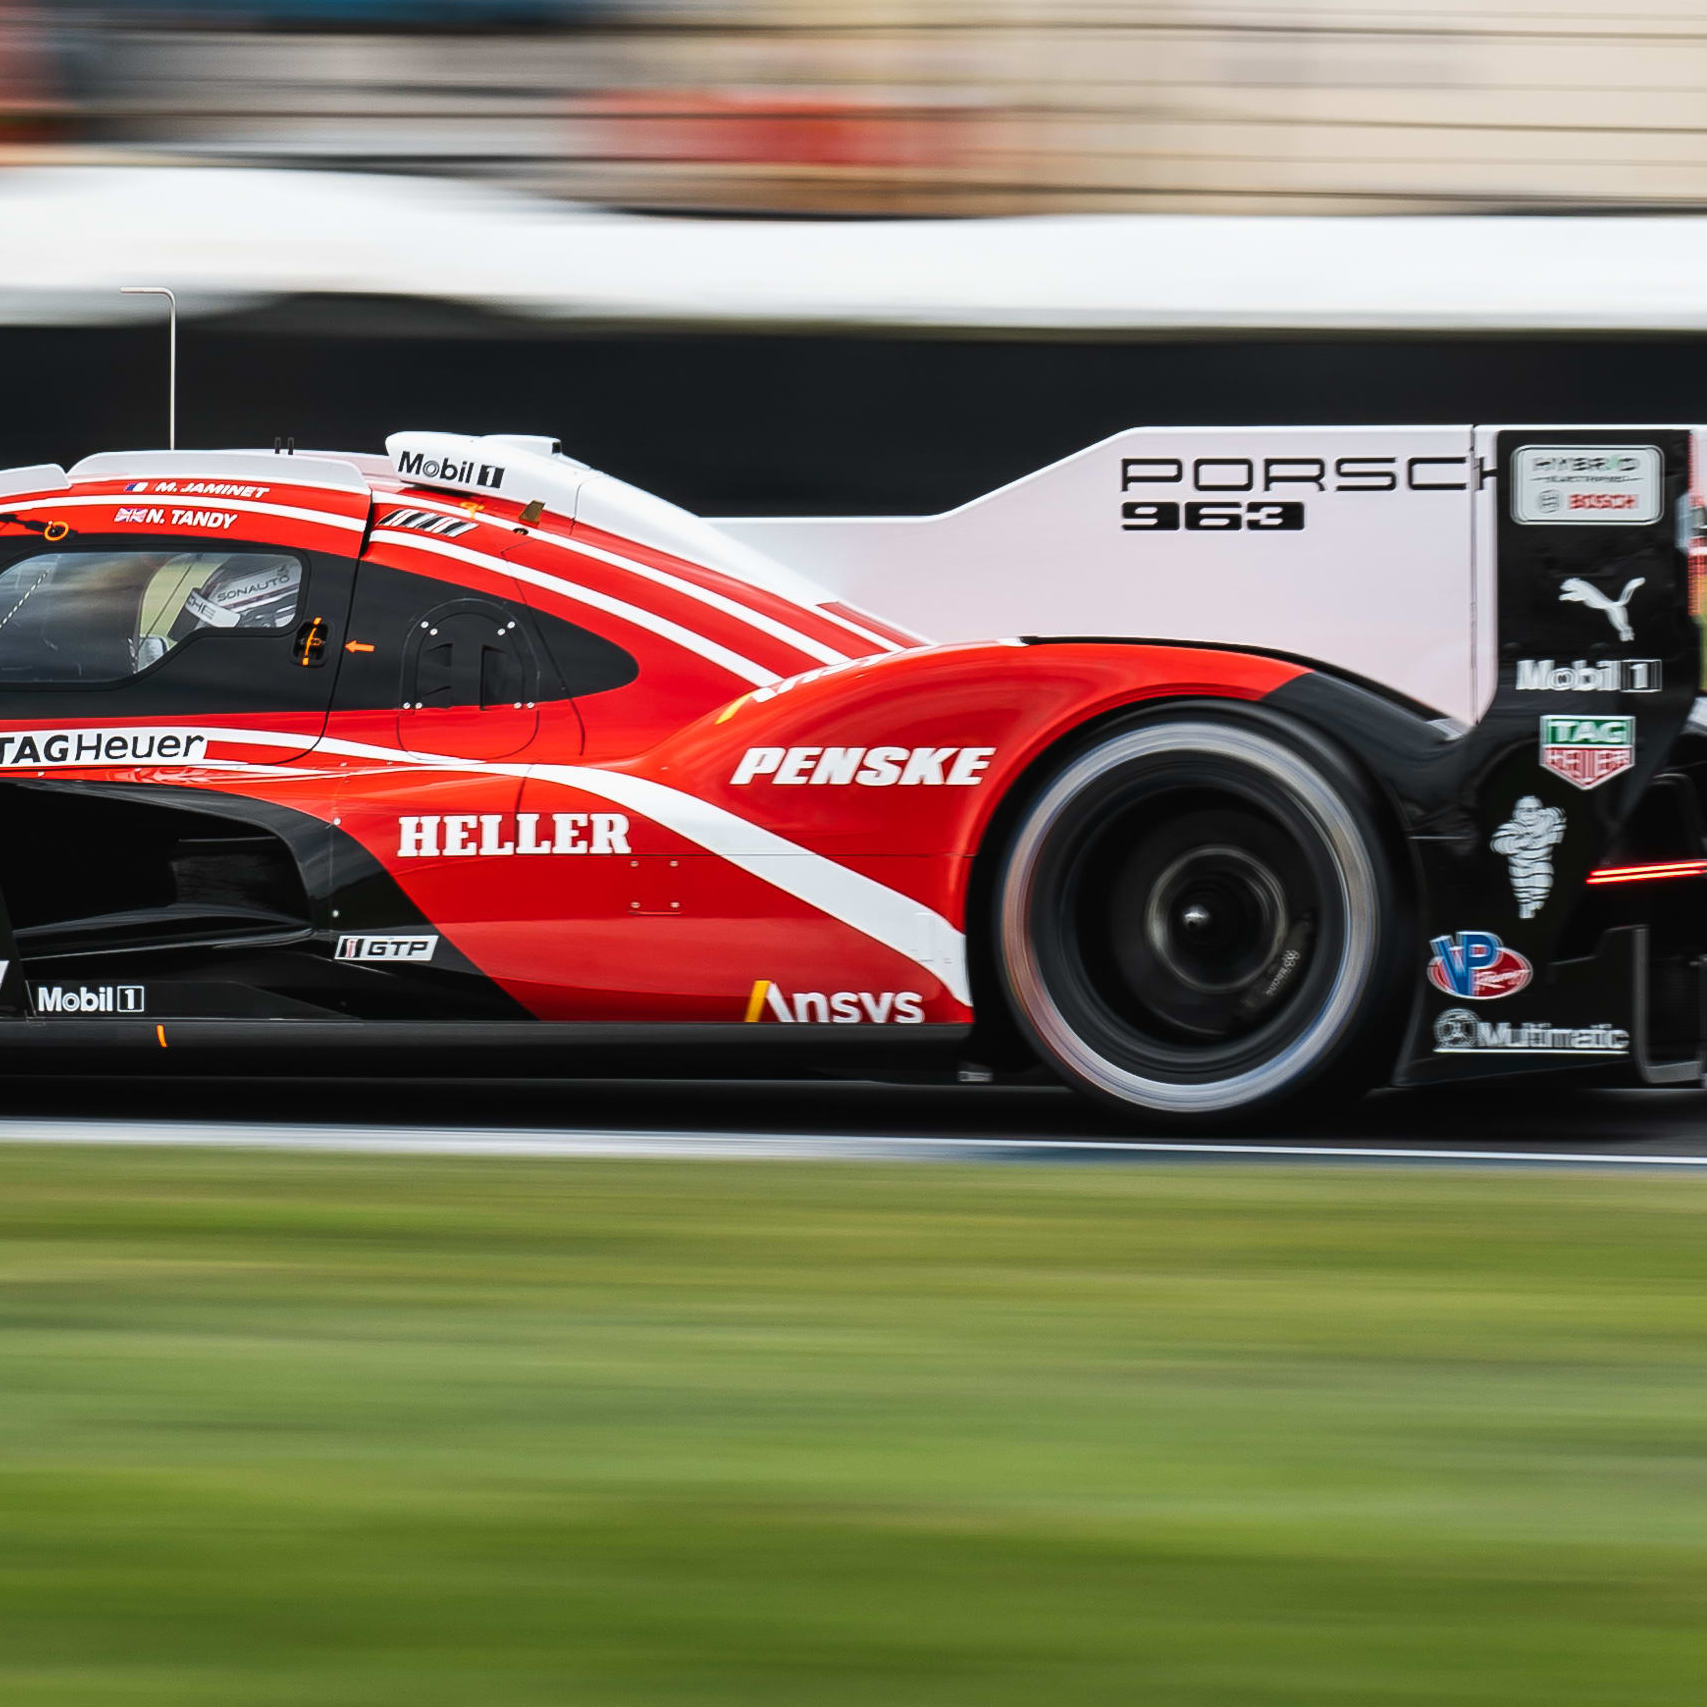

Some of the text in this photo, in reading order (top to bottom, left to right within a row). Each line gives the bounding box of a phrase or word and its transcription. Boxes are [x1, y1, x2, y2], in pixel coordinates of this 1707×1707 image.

[398, 451, 474, 483] Mobil
[155, 482, 270, 498] M. JAMINET
[145, 508, 238, 529] N. TANDY
[1121, 501, 1305, 531] 963
[217, 574, 291, 602] SONAUTO
[1516, 659, 1621, 691] Mobil
[1548, 720, 1628, 743] TAG
[729, 746, 997, 787] PENSKE
[397, 813, 632, 857] HELLER
[367, 941, 429, 956] GTP
[38, 986, 114, 1012] Mobil
